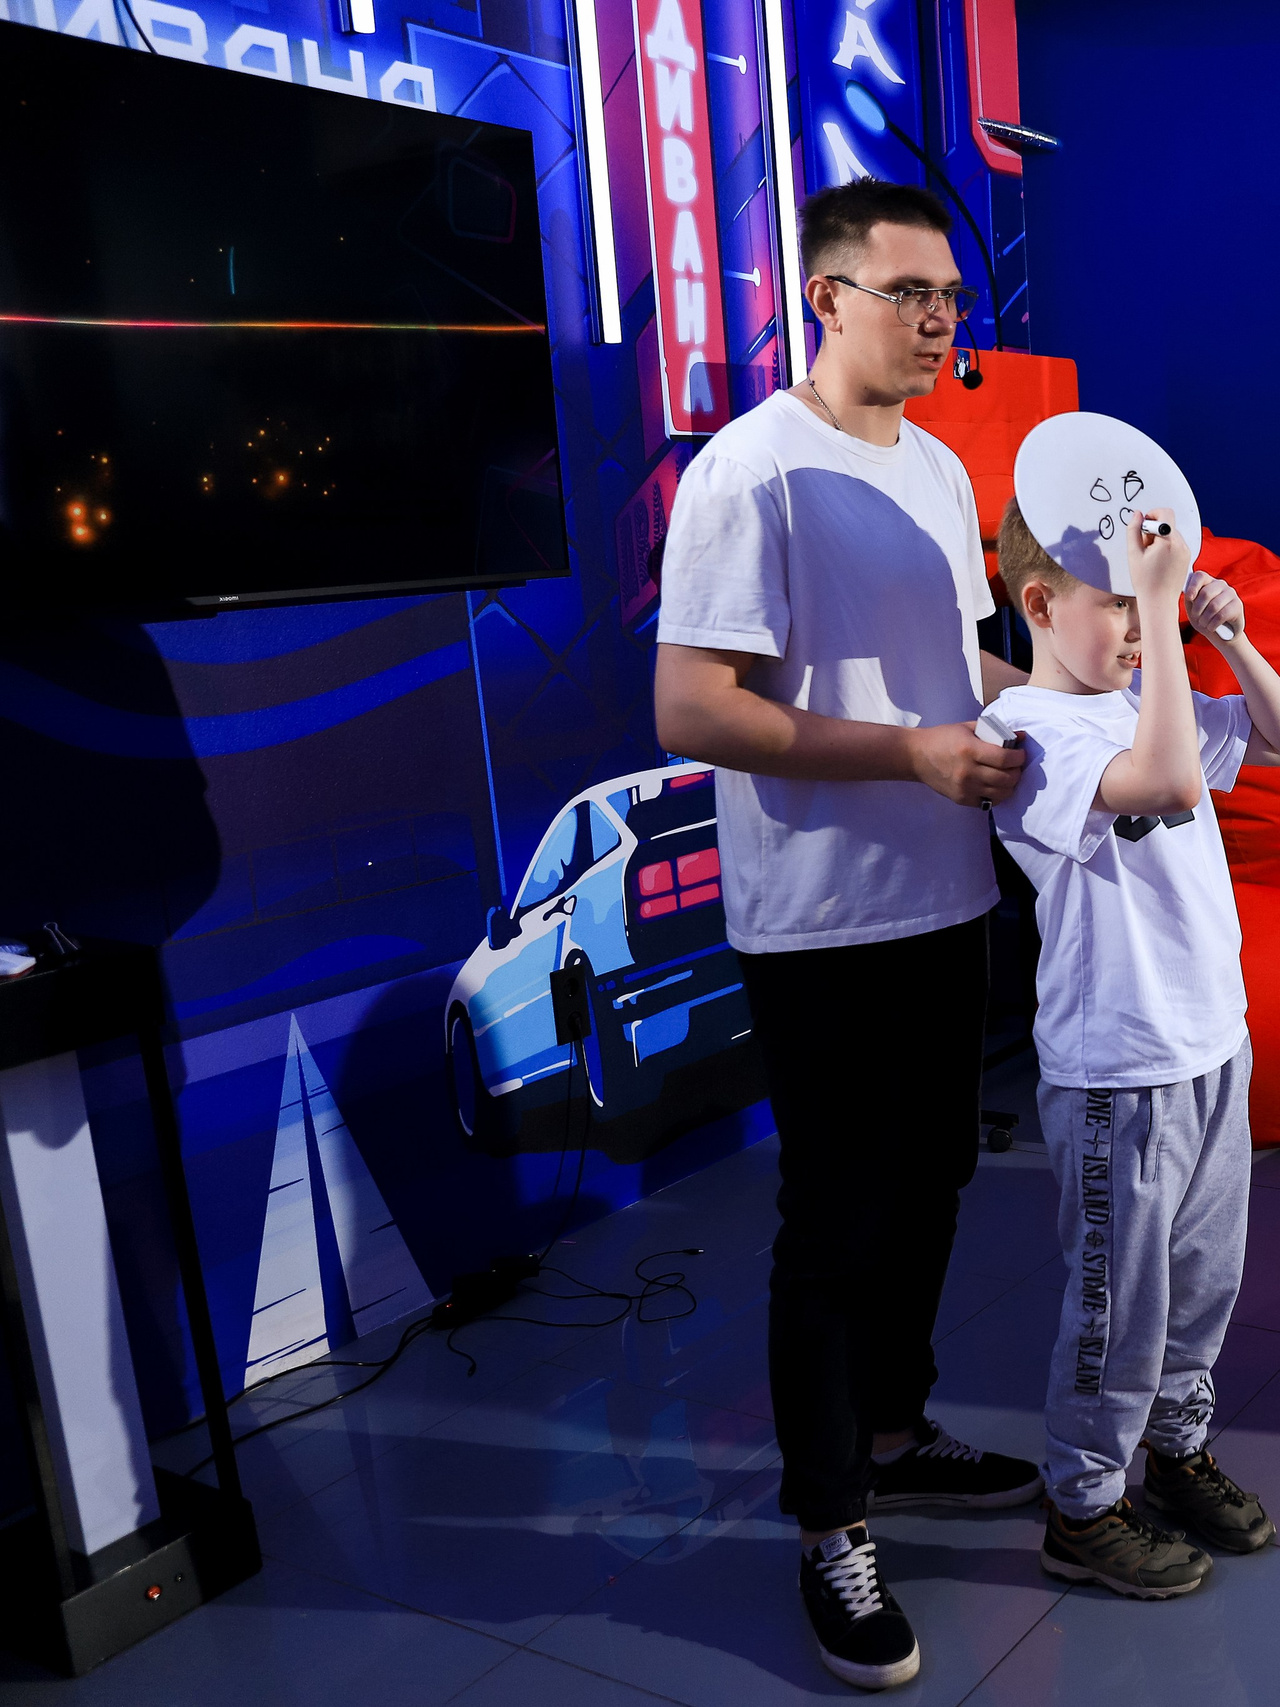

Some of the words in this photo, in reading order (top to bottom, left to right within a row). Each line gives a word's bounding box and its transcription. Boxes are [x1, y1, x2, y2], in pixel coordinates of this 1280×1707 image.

[1085, 1088, 1112, 1128] ONE
[1082, 1152, 1109, 1225] ISLAND
[1082, 1251, 1106, 1314] STONE
[1074, 1335, 1105, 1394] ISLAND
